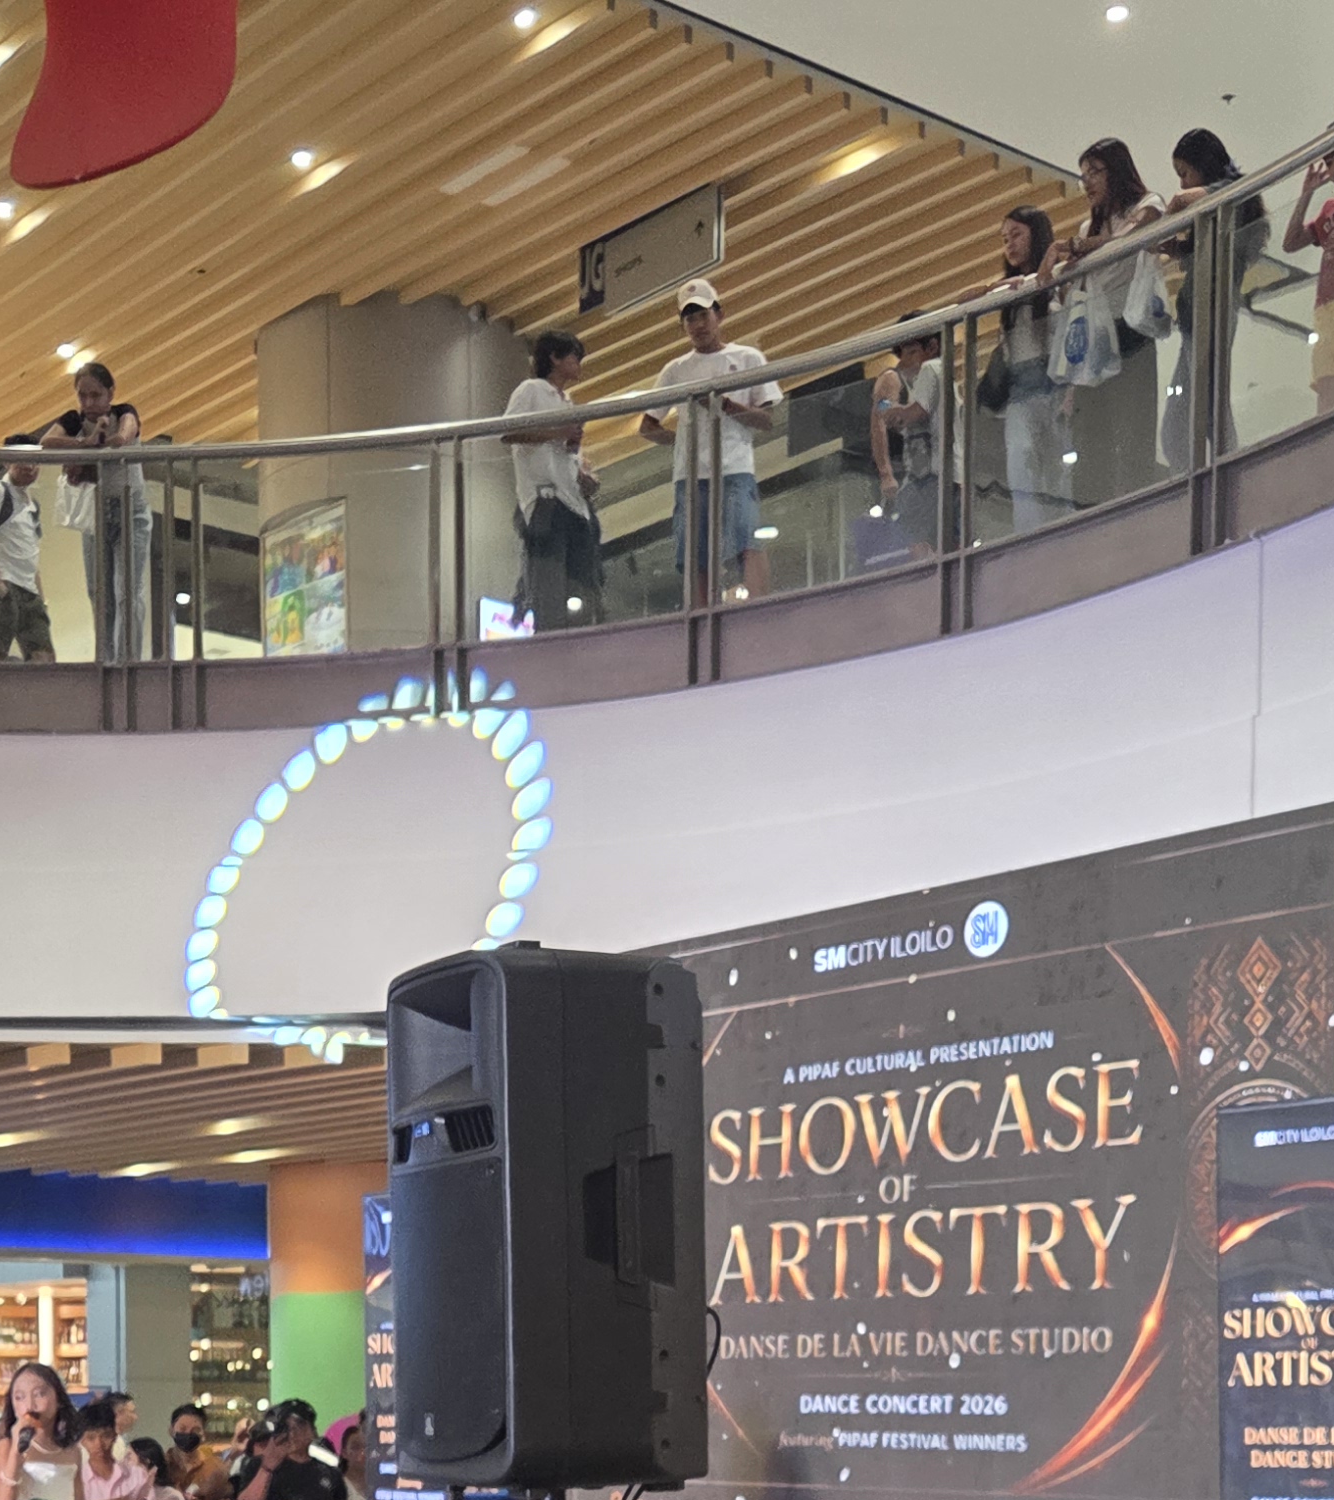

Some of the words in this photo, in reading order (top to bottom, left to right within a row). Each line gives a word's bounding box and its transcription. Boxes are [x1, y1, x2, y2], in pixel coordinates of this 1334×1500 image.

[891, 924, 954, 959] ILOILO
[783, 1067, 796, 1085] A
[799, 1062, 841, 1083] PIPAF
[845, 1048, 926, 1077] CULTURAL
[930, 1029, 1055, 1064] PRESENTATION
[708, 1058, 1143, 1186] SHOWCASE
[878, 1174, 918, 1203] OF
[709, 1193, 1137, 1307] ARTISTRY
[720, 1334, 790, 1359] DANSE
[796, 1334, 827, 1358] DE
[833, 1333, 862, 1357] LA
[869, 1331, 909, 1357] VIE
[916, 1328, 1005, 1356] DANCE
[1011, 1326, 1114, 1355] STUDIO
[799, 1395, 861, 1415] DANCE
[865, 1394, 953, 1415] CONCERT
[959, 1395, 1009, 1416] 2026
[838, 1433, 878, 1449] PIPAF
[882, 1433, 950, 1451] FESTIVAL
[953, 1434, 1029, 1453] WINNERS
[1243, 1426, 1301, 1446] DANSE
[1303, 1426, 1328, 1446] DE
[1250, 1449, 1310, 1469] DANCE
